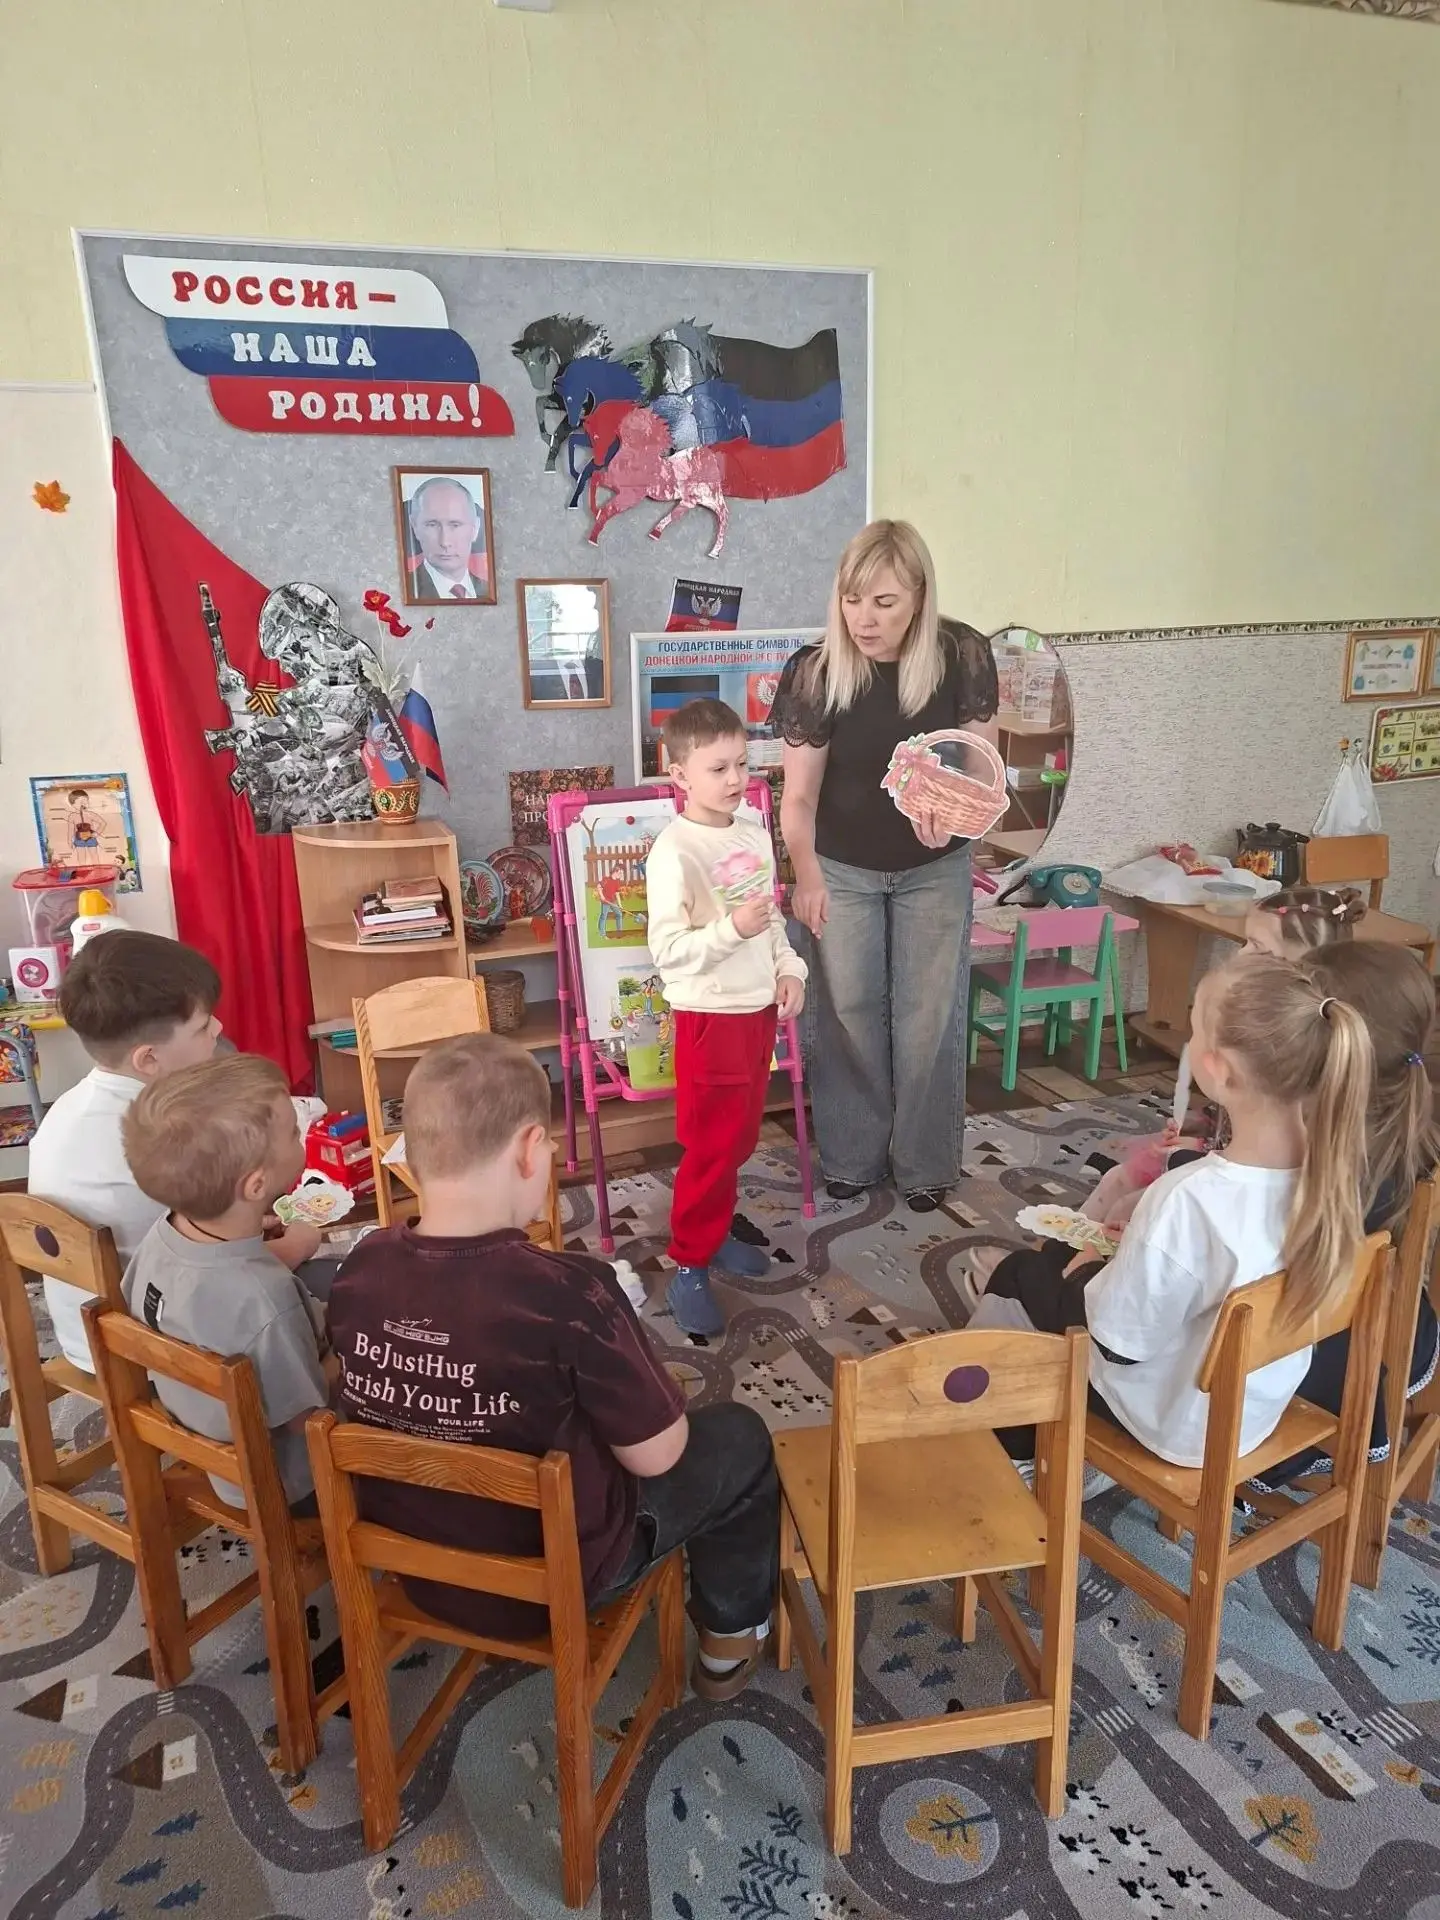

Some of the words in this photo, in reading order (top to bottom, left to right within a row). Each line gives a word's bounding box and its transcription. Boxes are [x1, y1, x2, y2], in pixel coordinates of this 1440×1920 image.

[171, 270, 358, 311] РОССИЯ
[230, 332, 376, 367] НАША
[268, 383, 482, 428] РОДИНА!
[644, 653, 701, 667] ДОНЕЦКОЙ
[700, 652, 753, 665] НАРОДНОЙ
[658, 639, 754, 653] ГОСУДАРСТВЕННЫЕ
[354, 1332, 477, 1388] BeJustHug
[338, 1352, 396, 1403] erish
[401, 1383, 462, 1415] Your
[472, 1391, 520, 1416] Life
[437, 1417, 462, 1427] YOUR
